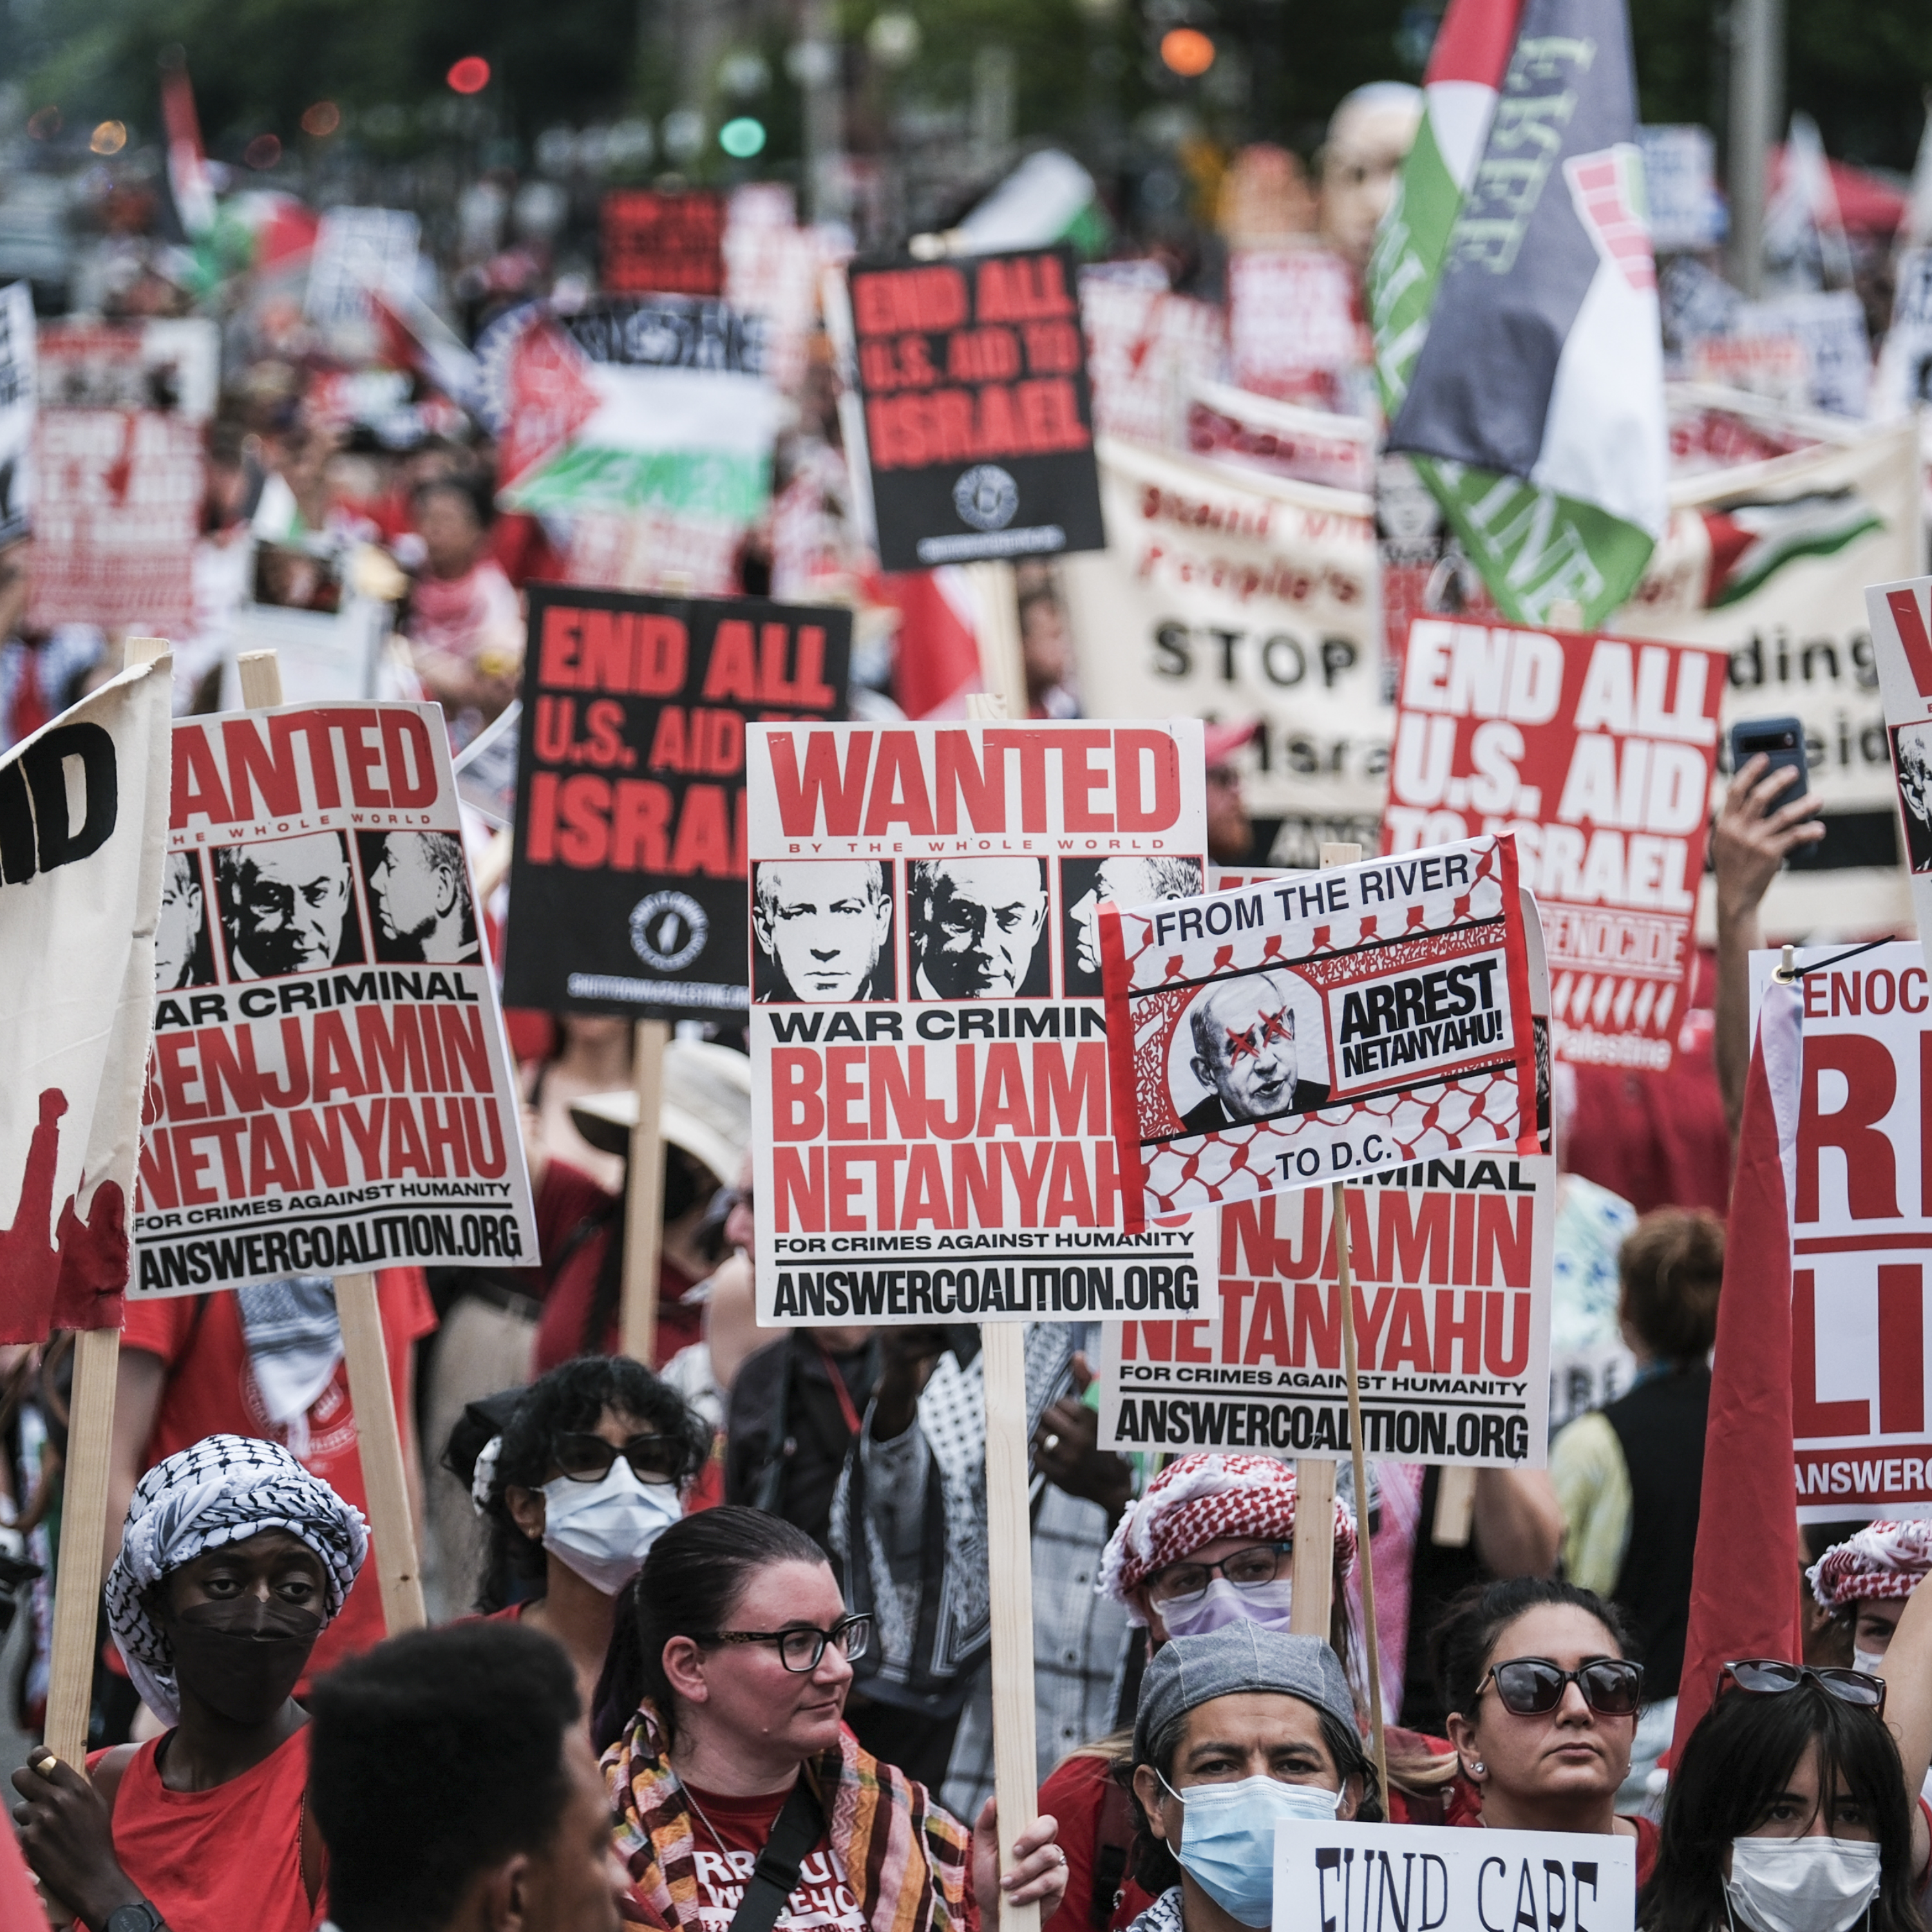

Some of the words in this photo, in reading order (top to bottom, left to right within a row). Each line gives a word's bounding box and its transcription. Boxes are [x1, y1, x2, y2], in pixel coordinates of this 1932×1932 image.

[853, 265, 969, 336] END
[976, 252, 1079, 323] ALL
[867, 377, 1092, 473] ISRAEL
[537, 605, 690, 697] END
[701, 618, 835, 708] ALL
[1155, 620, 1359, 689] STOP
[1401, 618, 1566, 725] END
[1574, 639, 1717, 747] ALL
[533, 695, 638, 770] U.S.
[648, 705, 745, 775] AID
[766, 728, 1181, 837] WANTED
[1392, 710, 1542, 819] U.S.
[1556, 733, 1708, 837] AID
[229, 815, 330, 838] WHOLE
[351, 813, 432, 825] WORLD
[789, 843, 823, 853] BY
[848, 842, 903, 853] THE
[929, 840, 1033, 852] WHOLE
[1057, 838, 1166, 850] WORLD
[1155, 888, 1265, 947] FROM
[1274, 877, 1350, 922] THE
[1359, 853, 1470, 909] RIVER
[1483, 817, 1695, 914] SRAEL
[238, 971, 478, 1019] CRIMINAL
[768, 1010, 903, 1043] WAR
[1339, 957, 1499, 1045] ARREST
[1803, 967, 1929, 1019] ENOC
[1343, 1009, 1504, 1079] NETANYAHU!
[771, 1042, 1115, 1142] BENJAM
[135, 1097, 507, 1213] NETANYAHU
[772, 1141, 1193, 1233] NETANYAH
[1275, 1148, 1321, 1181] TO
[1331, 1133, 1392, 1171] D.C.
[136, 1213, 182, 1233] FOR
[187, 1198, 283, 1224] CRIMES
[289, 1184, 395, 1211] AGAINST
[401, 1182, 511, 1198] HUMANITY
[775, 1238, 826, 1253] FOR
[831, 1235, 932, 1252] CRIMES
[937, 1233, 1050, 1251] AGAINST
[1055, 1231, 1195, 1247] HUMANITY
[139, 1215, 523, 1291] ANSWERCOALITION.ORG
[773, 1265, 1199, 1317] ANSWERCOALITION.ORG
[1120, 1366, 1171, 1381] FOR
[1176, 1368, 1273, 1386] CRIMES
[1277, 1371, 1387, 1390] AGAINST
[1392, 1376, 1528, 1397] HUMANITY
[1115, 1399, 1529, 1459] ANSWERCOALITION.ORG
[1795, 1457, 1932, 1495] ANSWER
[1315, 1847, 1448, 1932] FUND
